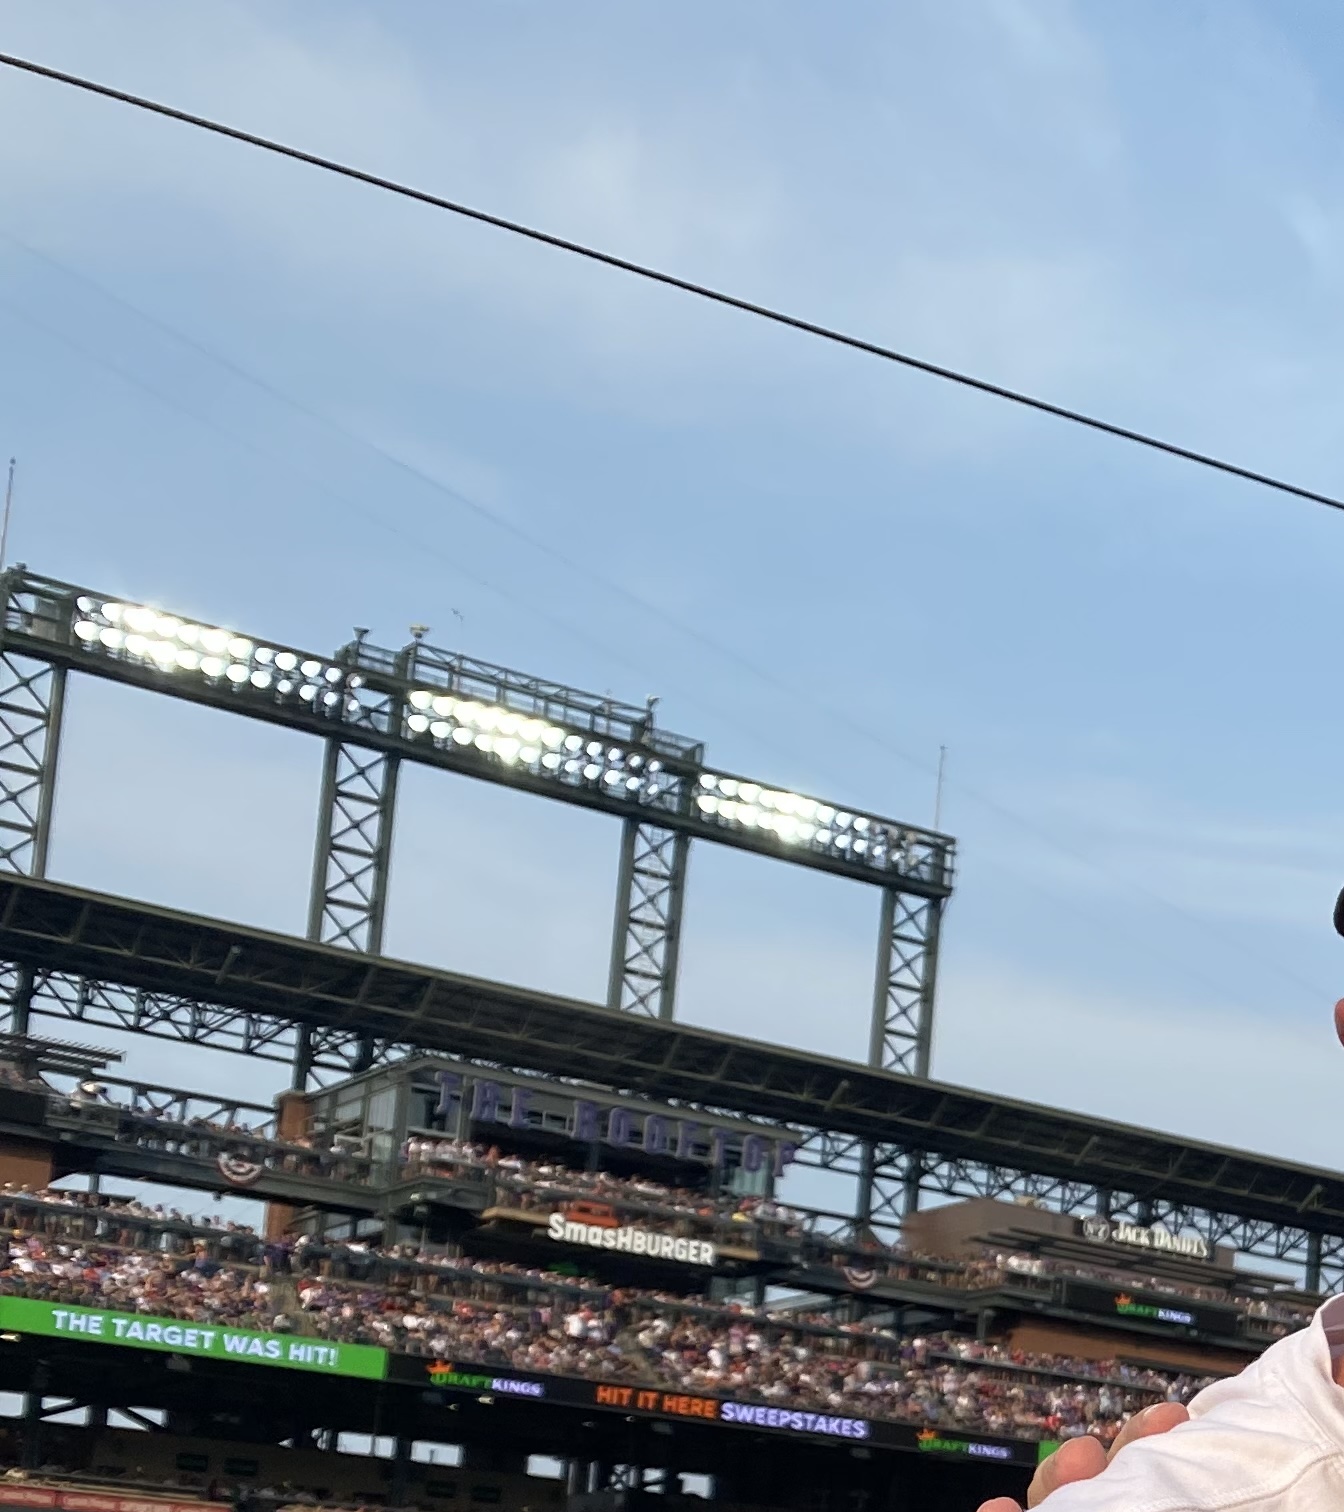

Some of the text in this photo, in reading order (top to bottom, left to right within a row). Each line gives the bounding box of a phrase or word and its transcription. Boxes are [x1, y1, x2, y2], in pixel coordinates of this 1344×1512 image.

[434, 1070, 798, 1178] THE ROOFTOP
[52, 1309, 340, 1368] THE TARGET WAS HIT!
[596, 1385, 872, 1440] HIT IT HERE SWEEPSTAKES
